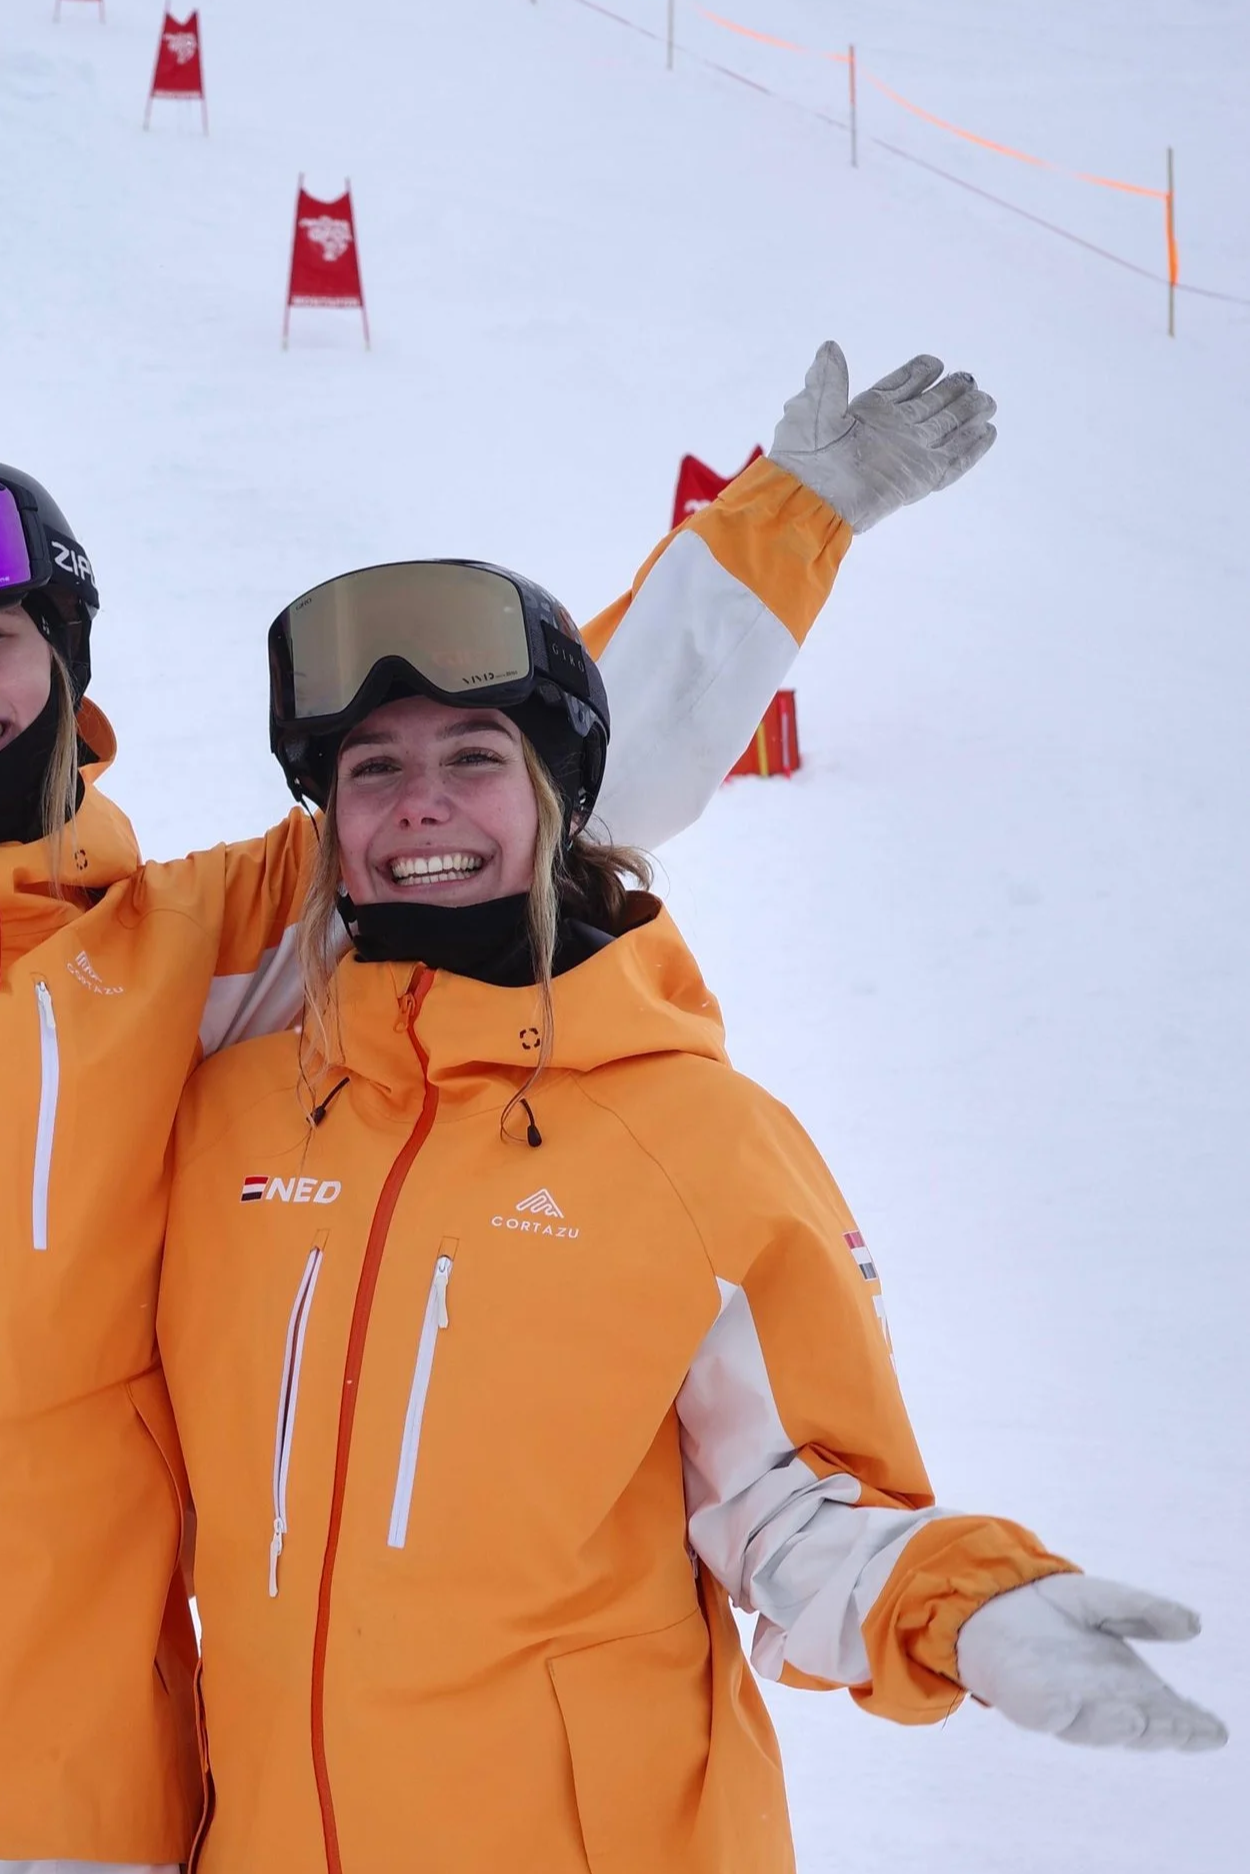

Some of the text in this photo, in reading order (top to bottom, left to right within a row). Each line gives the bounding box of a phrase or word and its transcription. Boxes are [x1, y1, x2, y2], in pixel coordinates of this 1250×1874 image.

[552, 643, 585, 673] GIRO
[265, 1177, 342, 1205] NED
[491, 1215, 580, 1240] CORTAZU
